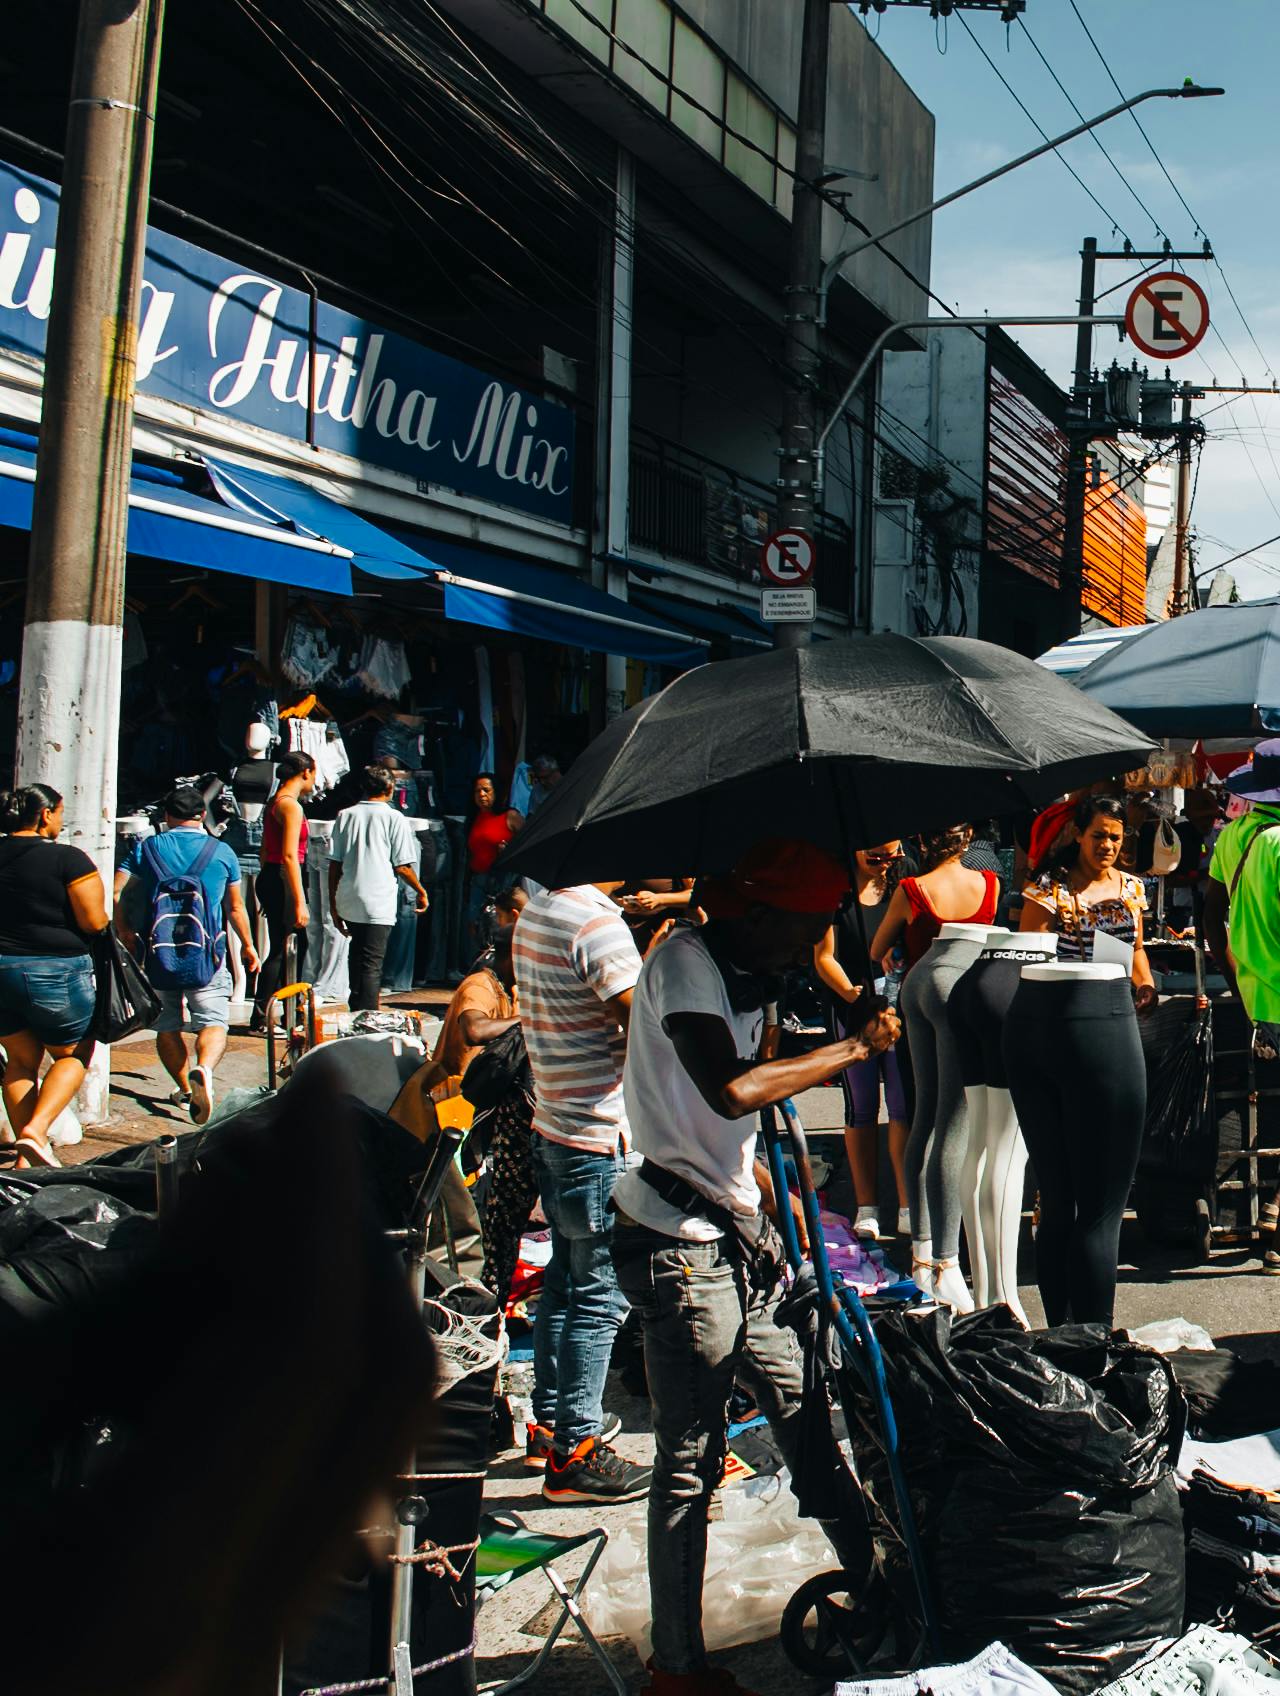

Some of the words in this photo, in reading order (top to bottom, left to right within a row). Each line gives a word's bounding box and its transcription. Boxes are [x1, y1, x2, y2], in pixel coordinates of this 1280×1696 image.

[1153, 291, 1183, 340] E
[208, 275, 441, 451] Jutha
[453, 382, 568, 496] Mix
[778, 541, 799, 572] E
[993, 950, 1046, 962] adidas
